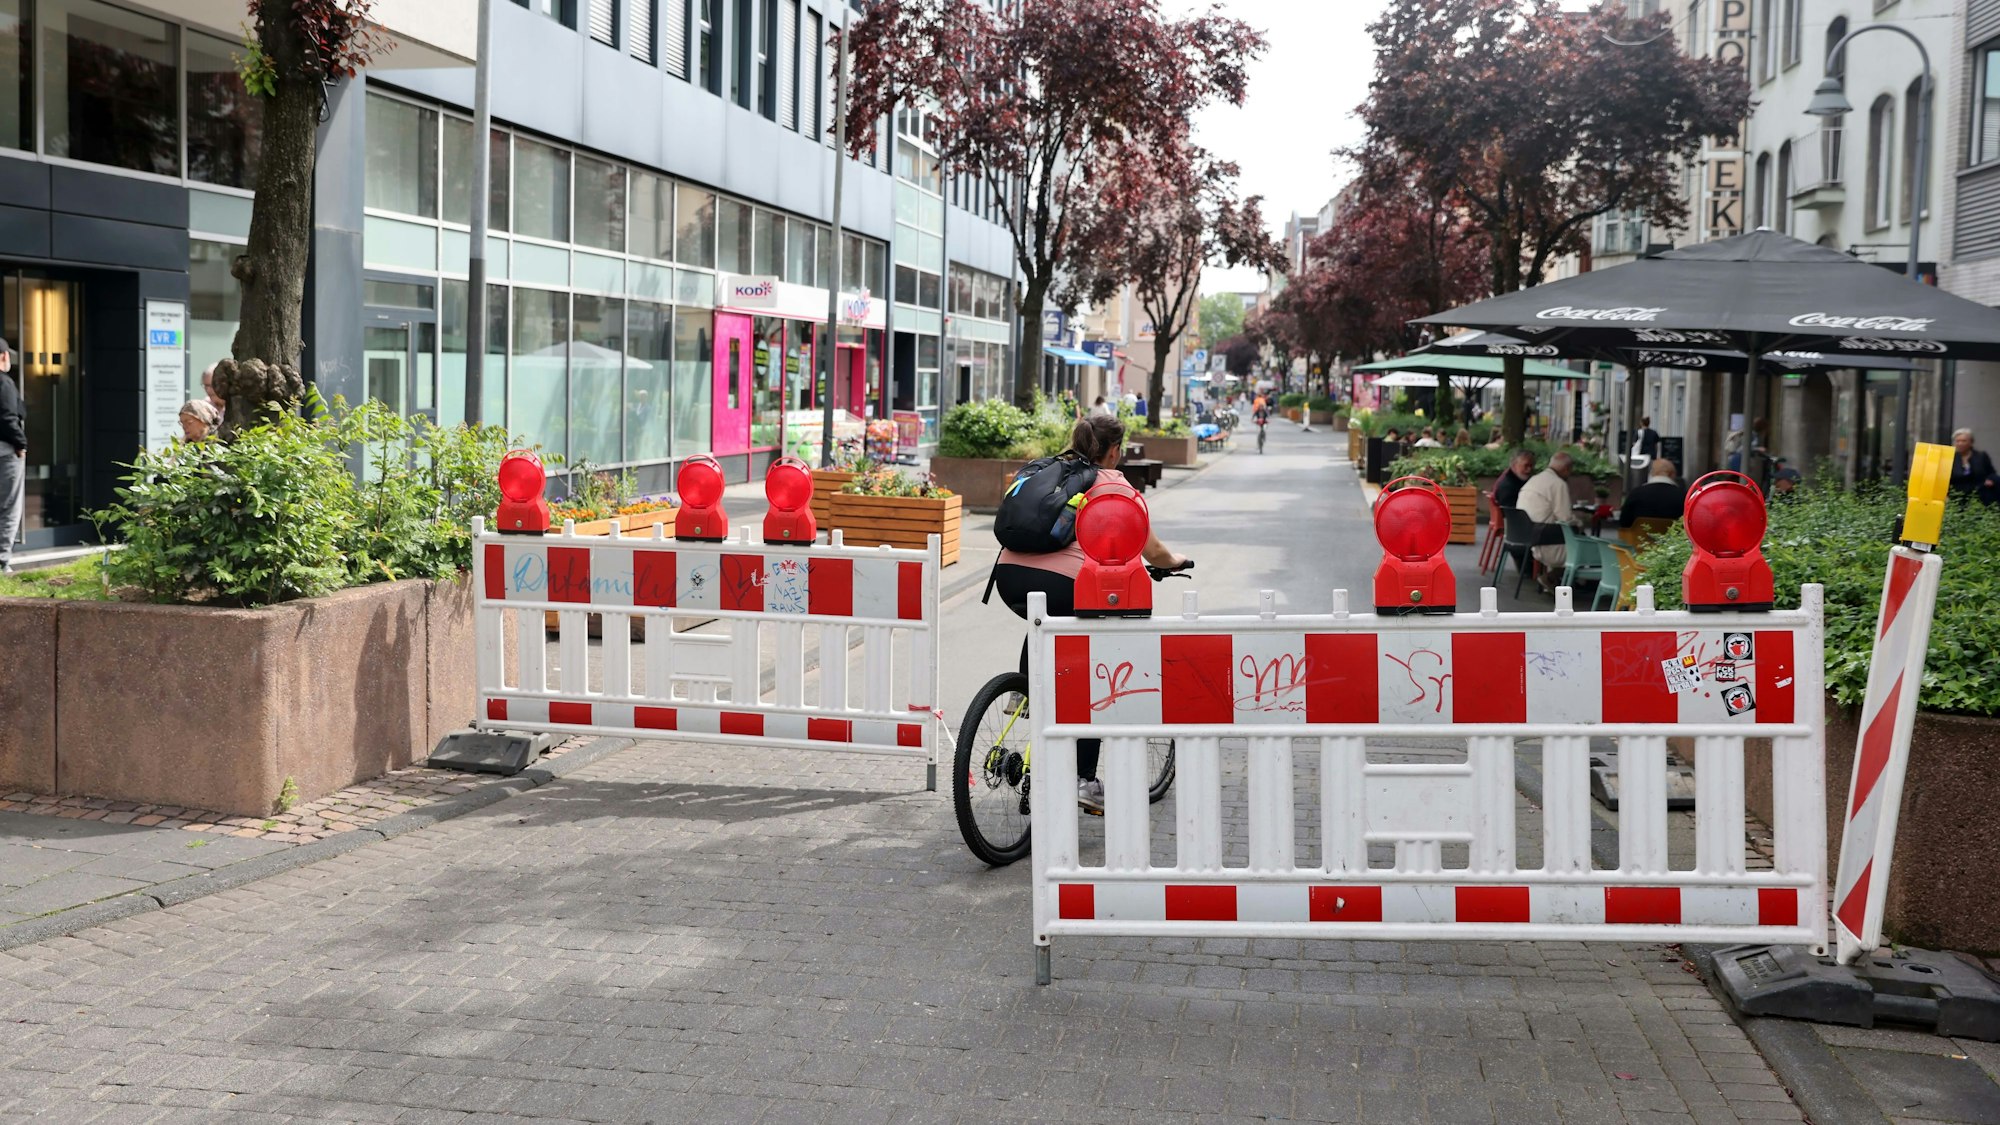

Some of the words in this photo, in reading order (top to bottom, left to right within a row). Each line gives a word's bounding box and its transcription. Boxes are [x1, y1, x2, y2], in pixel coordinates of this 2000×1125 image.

[1536, 306, 1668, 321] Coca-Cola
[1789, 312, 1936, 331] Coca-Cola
[151, 331, 170, 343] LVR
[1716, 665, 1734, 673] FCK
